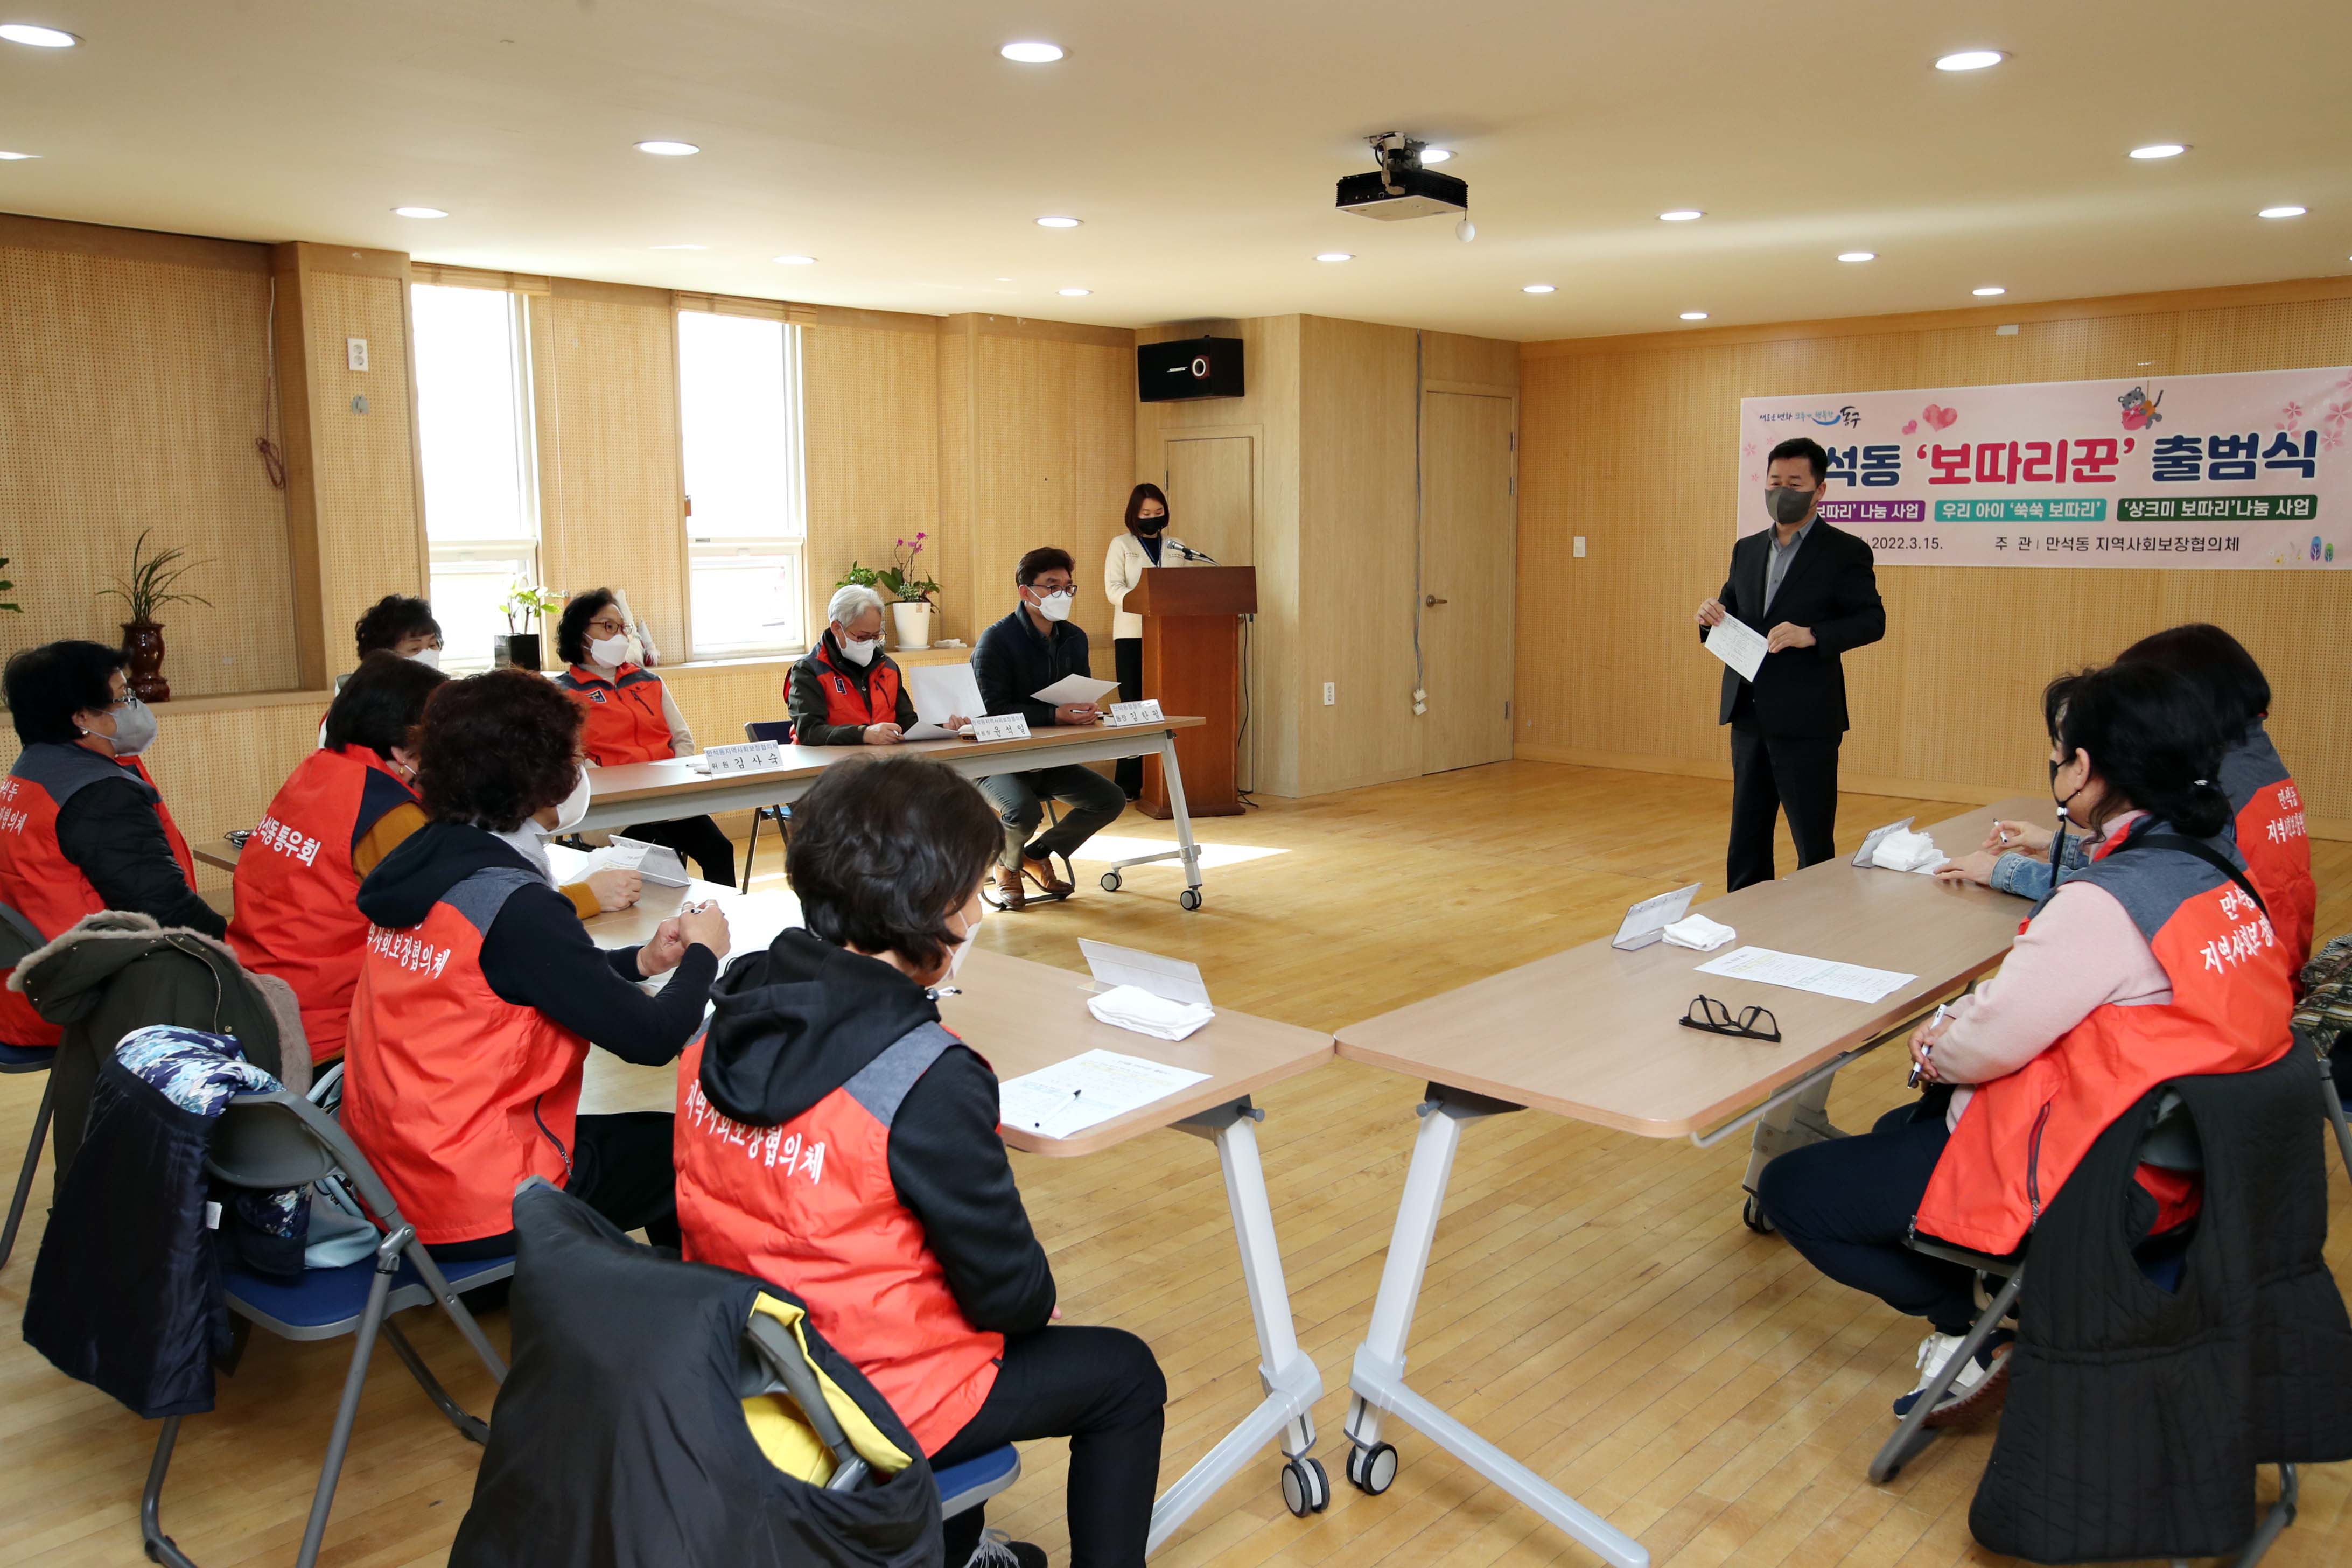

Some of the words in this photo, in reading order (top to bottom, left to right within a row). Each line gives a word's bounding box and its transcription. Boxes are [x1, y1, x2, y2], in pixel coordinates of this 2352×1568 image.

[1826, 445, 1901, 487] 석동
[1916, 437, 2136, 485] ‘보따리꾼’
[2152, 430, 2318, 482] 출범식
[1861, 503, 1887, 519] 나눔
[1892, 503, 1919, 519] 사업
[1942, 503, 1971, 519] 우리
[1976, 502, 2004, 518] 아이
[2049, 501, 2101, 518] 보따리’
[2275, 498, 2310, 516] 사업
[1872, 537, 1943, 549] 2022.3.15.
[2046, 536, 2090, 551] 만석동
[2096, 536, 2239, 552] 지역사회보장협의체
[367, 922, 451, 979] 역사회보장협의체
